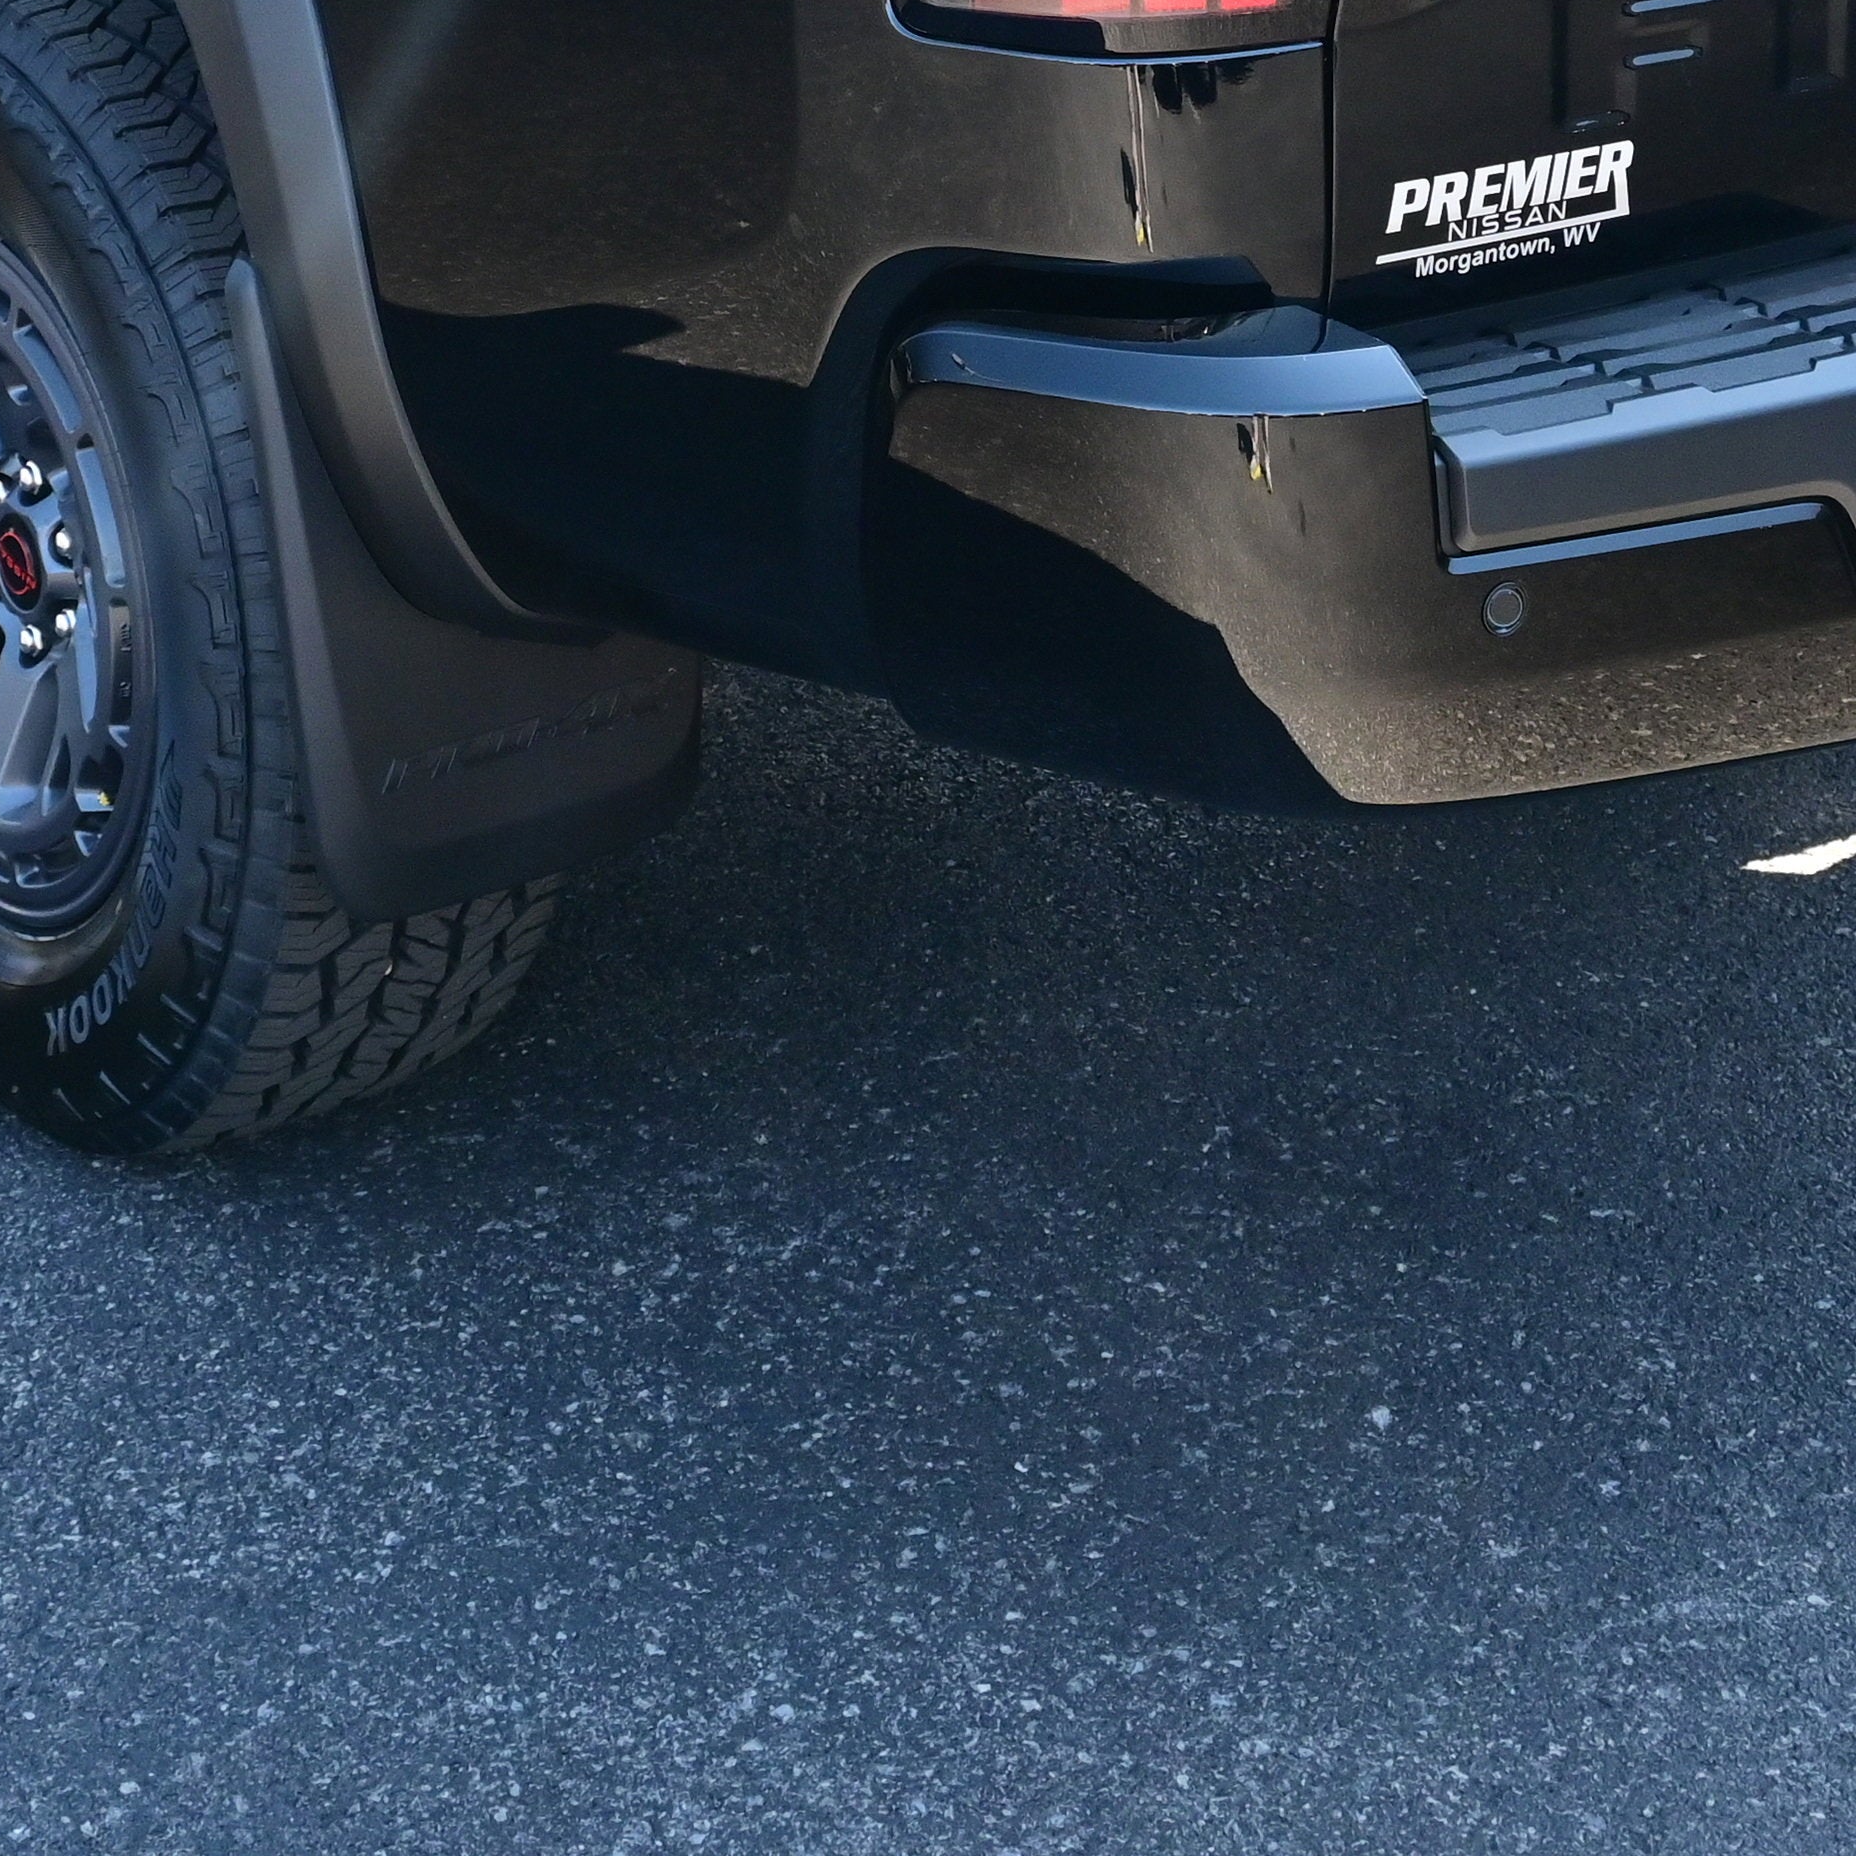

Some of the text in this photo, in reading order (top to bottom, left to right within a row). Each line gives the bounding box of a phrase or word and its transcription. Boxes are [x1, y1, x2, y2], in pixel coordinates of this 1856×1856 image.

[1385, 140, 1635, 234] PREMIER
[1447, 201, 1567, 242] NISSAN
[1415, 222, 1602, 278] Morgantown, WV
